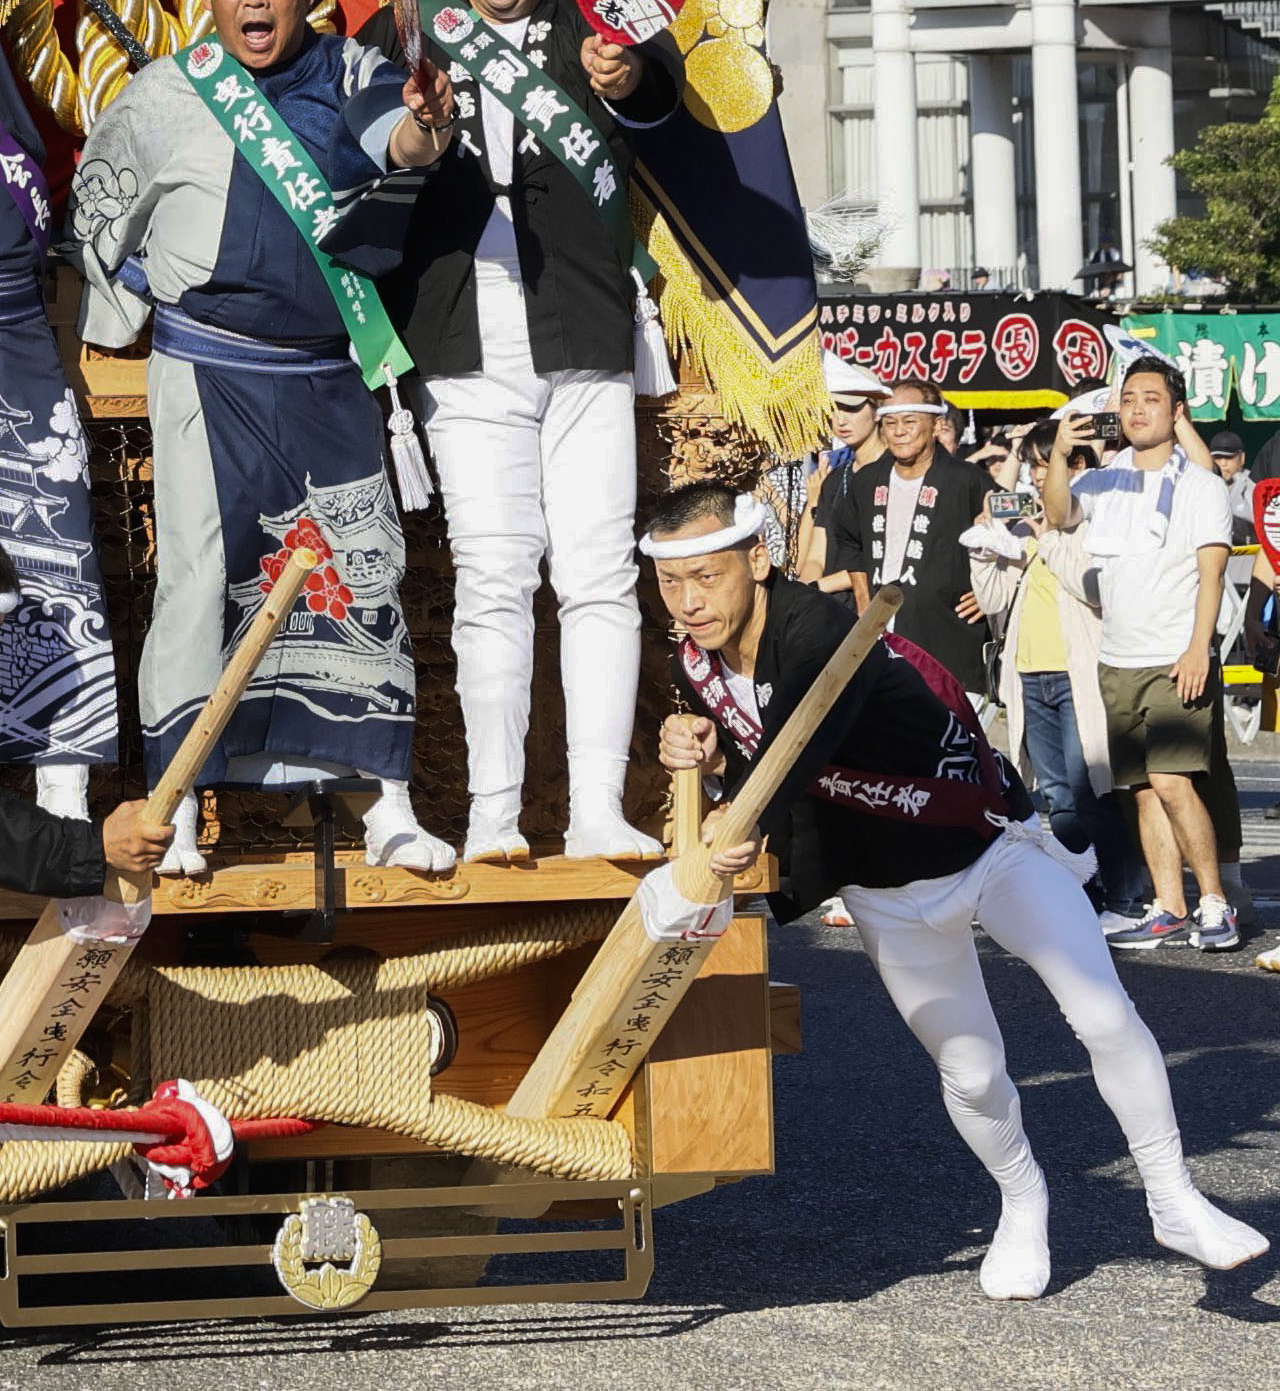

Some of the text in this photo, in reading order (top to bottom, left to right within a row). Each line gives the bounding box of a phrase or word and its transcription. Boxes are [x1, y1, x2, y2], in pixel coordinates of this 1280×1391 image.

[213, 75, 339, 245] 曳行責任者
[481, 49, 616, 206] 副責任者
[820, 301, 972, 324] ハチミツ・ミルク入り
[1176, 339, 1280, 409] 漬け
[817, 771, 931, 818] 責任者
